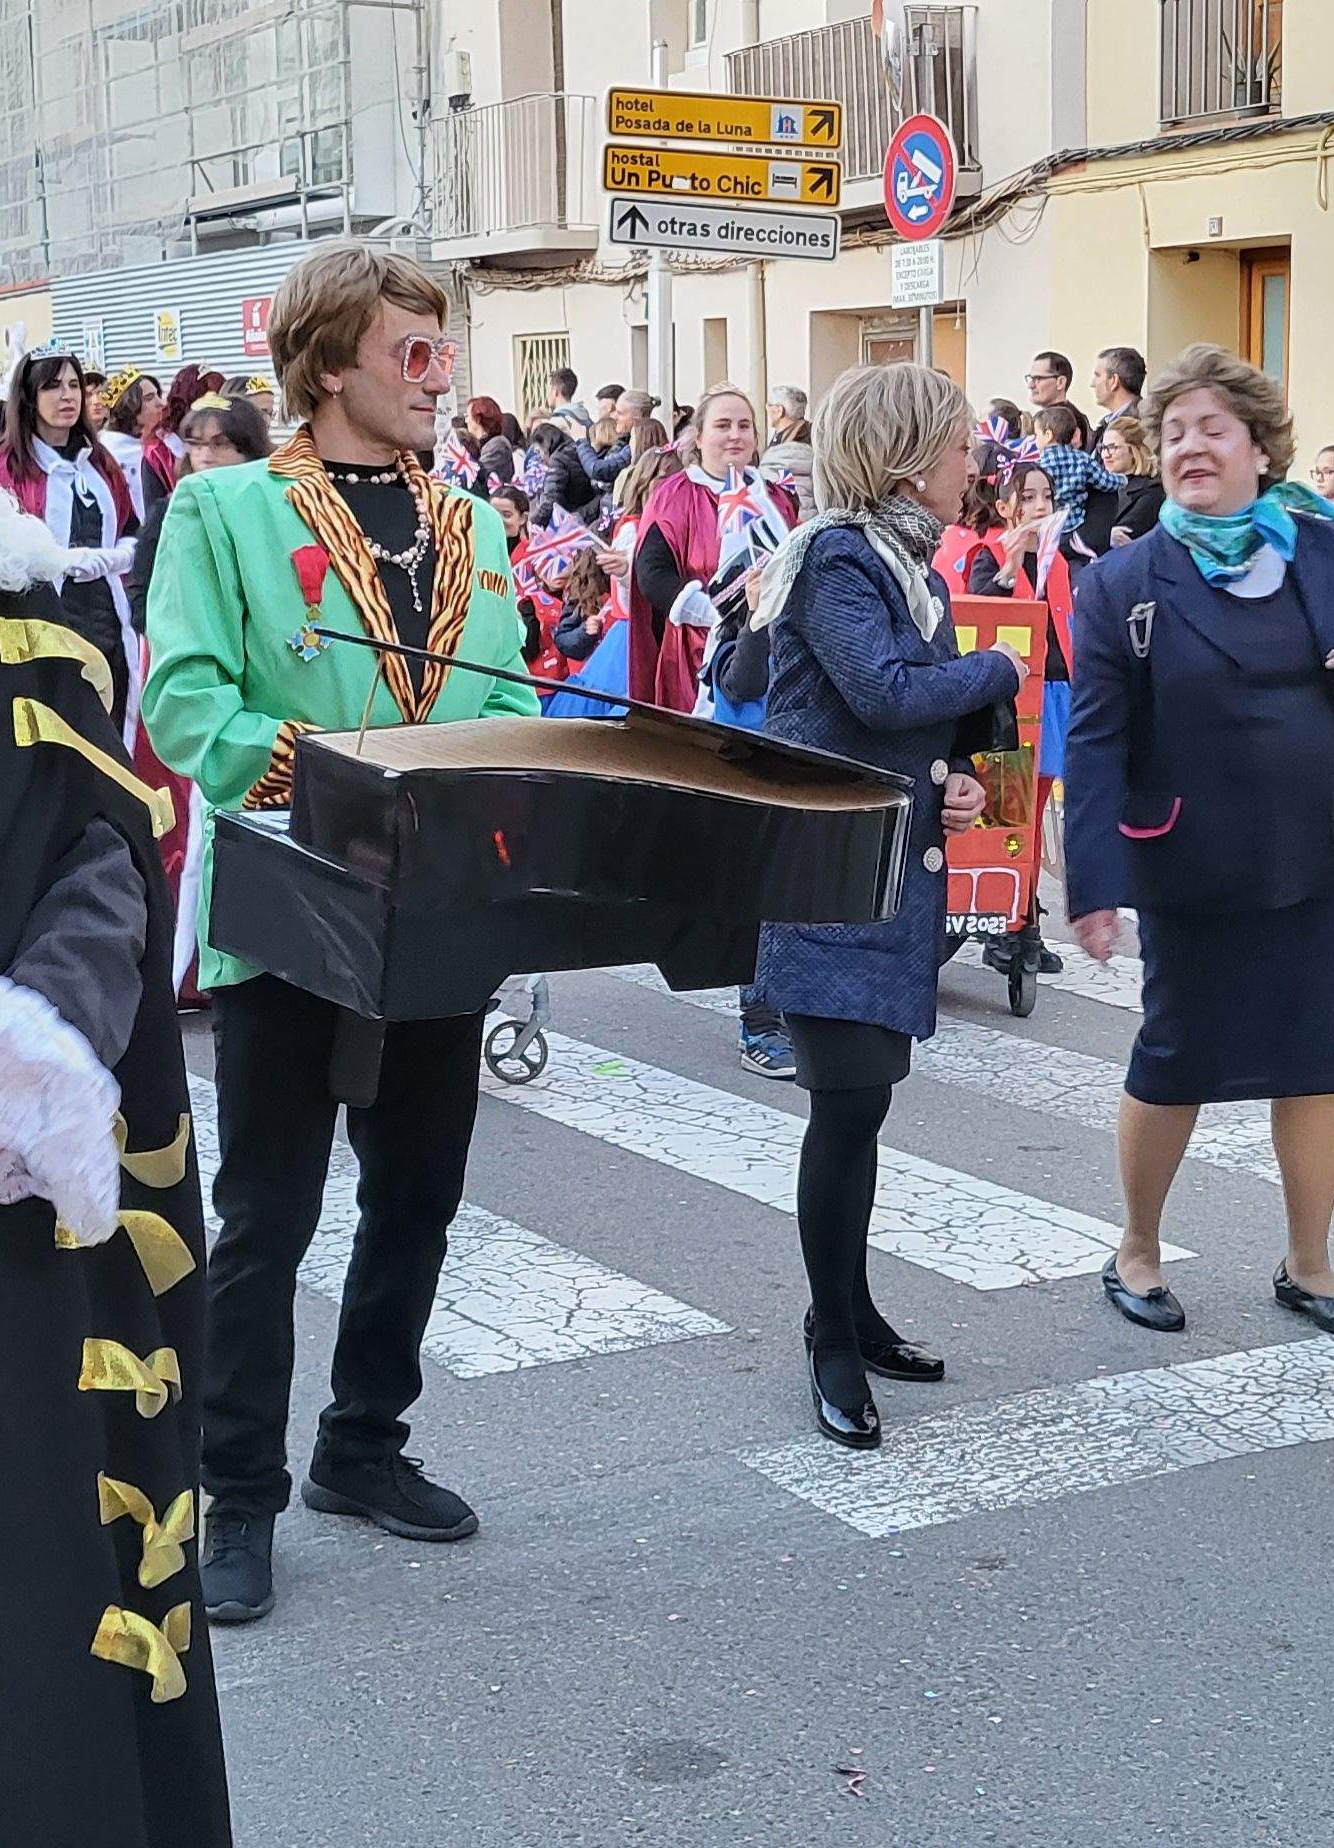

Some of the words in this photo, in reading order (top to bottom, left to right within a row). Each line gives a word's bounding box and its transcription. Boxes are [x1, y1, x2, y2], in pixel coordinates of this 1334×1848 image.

[616, 97, 654, 113] hotel
[615, 115, 670, 131] Posada
[675, 119, 694, 132] de
[698, 120, 711, 134] la
[717, 121, 753, 137] Luna
[611, 150, 660, 167] hostal
[611, 167, 640, 187] Un
[647, 170, 711, 191] Puto
[717, 174, 763, 196] Chic
[657, 217, 711, 237] otras
[717, 220, 831, 248] direcciones
